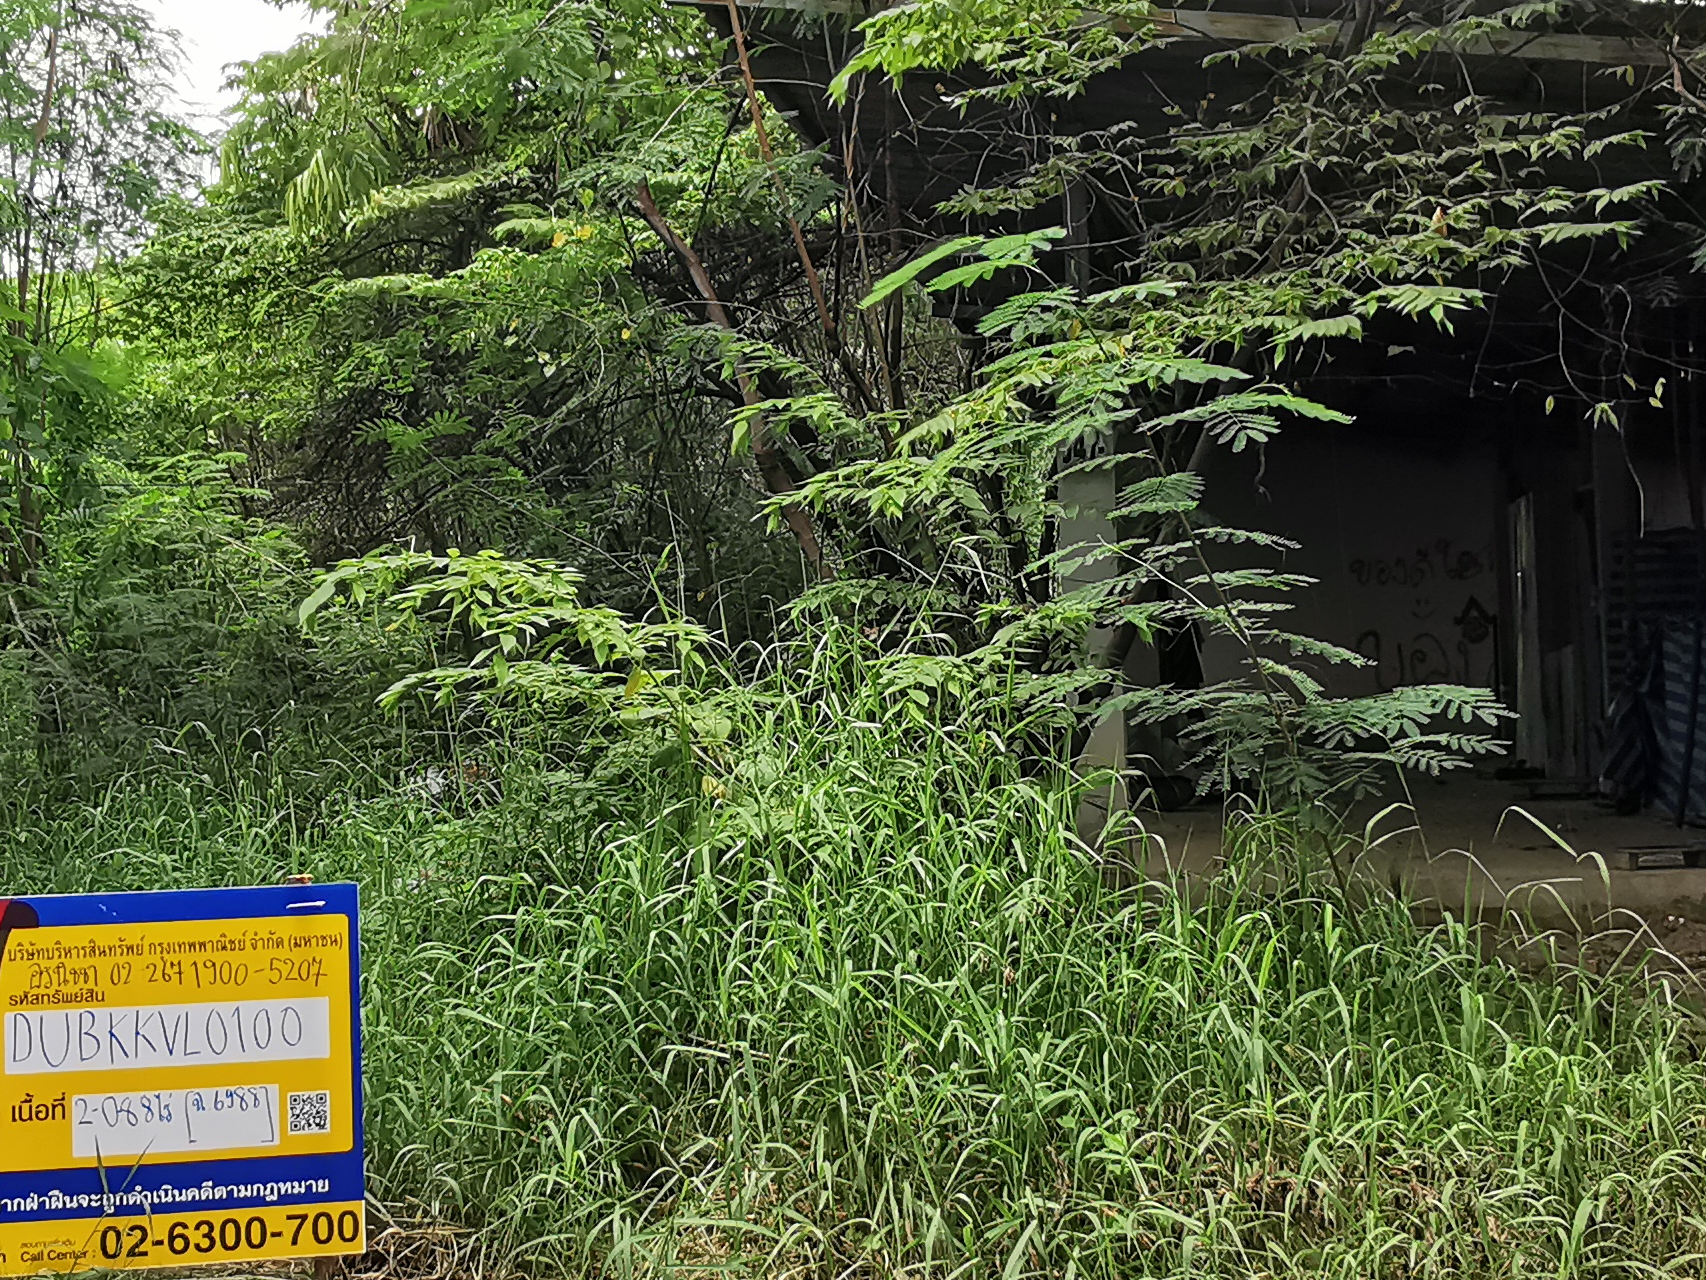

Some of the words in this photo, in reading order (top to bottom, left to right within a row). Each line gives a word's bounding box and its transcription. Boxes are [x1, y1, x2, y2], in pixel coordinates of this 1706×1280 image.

[250, 930, 284, 951] จำกัด
[289, 931, 343, 952] (มหาชน)
[8, 988, 105, 1007] รหัสทรัพย์สิน
[10, 1091, 67, 1123] เนื้อที่
[20, 1250, 44, 1263] Call
